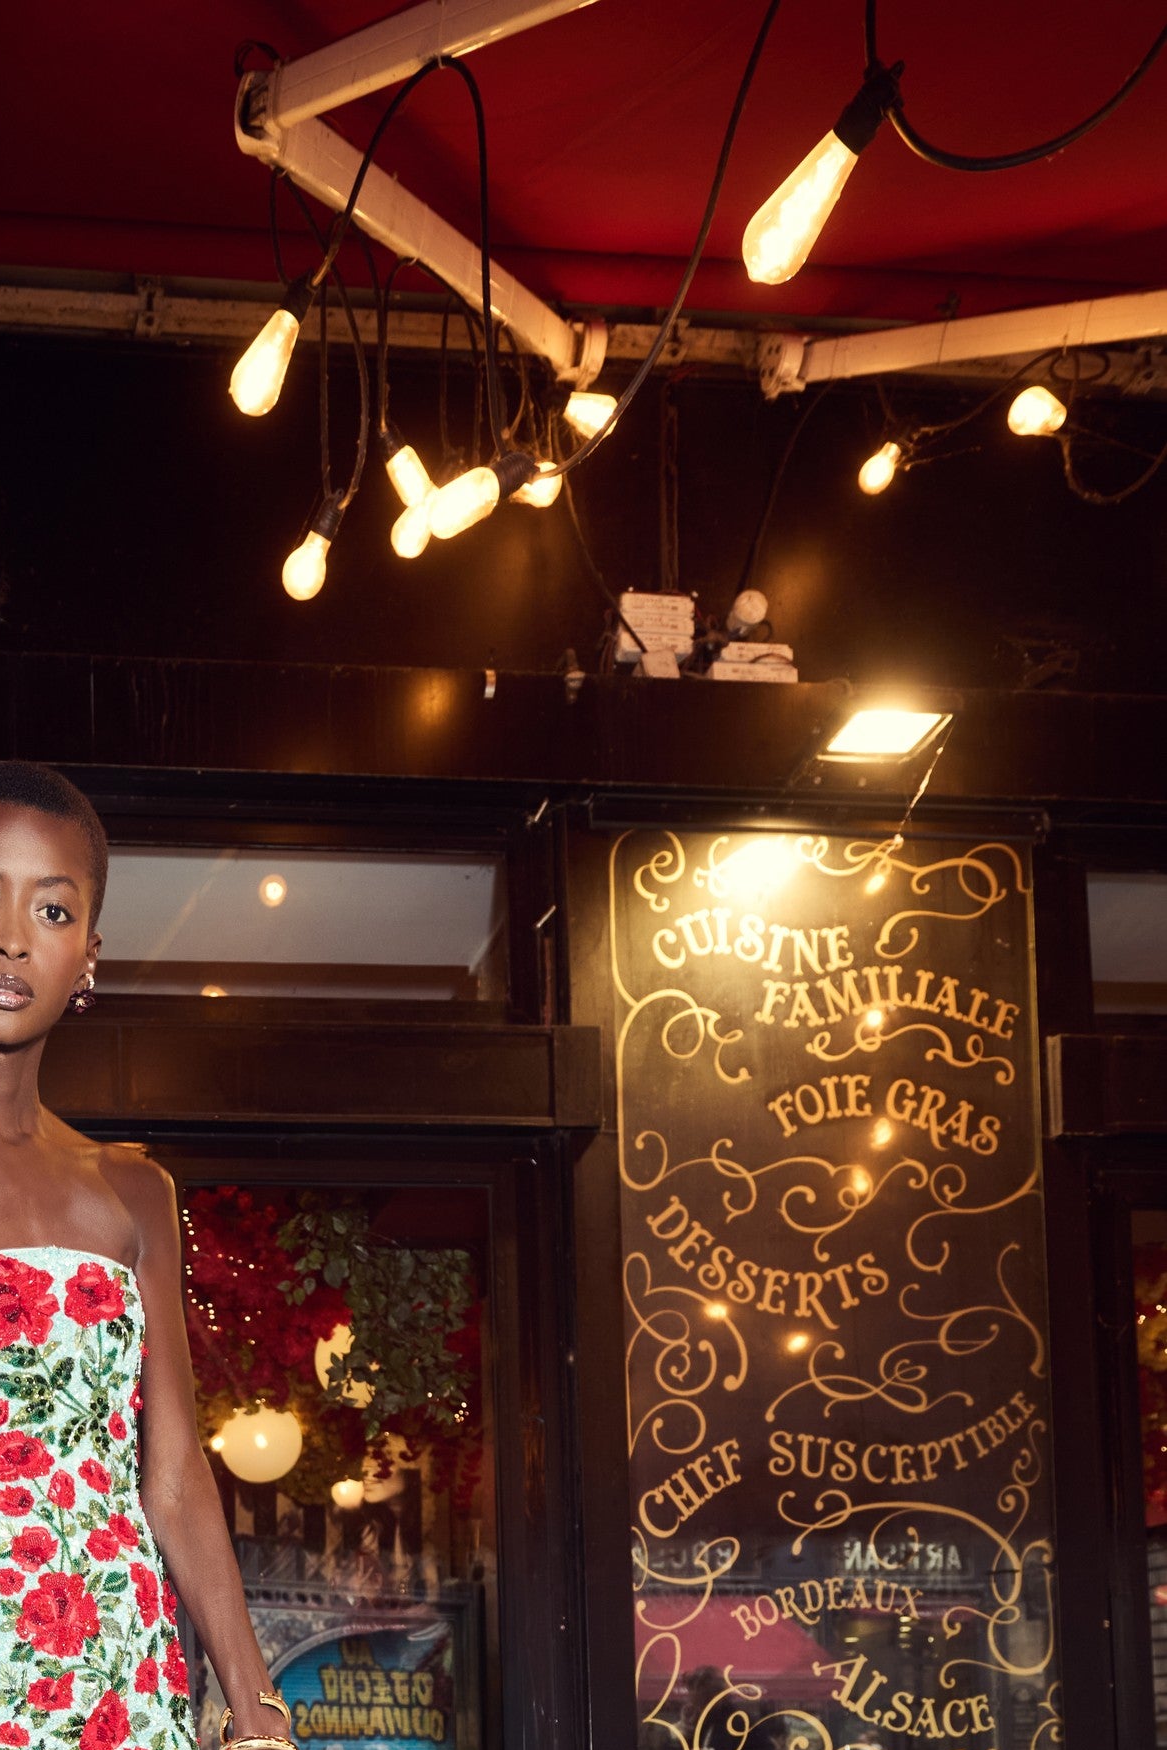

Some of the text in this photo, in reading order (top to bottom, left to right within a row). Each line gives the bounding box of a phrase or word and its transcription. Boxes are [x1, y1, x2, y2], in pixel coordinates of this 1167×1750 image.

[652, 906, 854, 975] CUISINE
[755, 965, 1021, 1041] FAMILIALE
[768, 1073, 1001, 1156] FOIE GRAS
[646, 1196, 891, 1330] DESSERTS
[638, 1390, 1037, 1539] CHEF SUSCEPTIBLE
[730, 1578, 925, 1641] BORDEAUX
[812, 1653, 996, 1740] ALSACE
